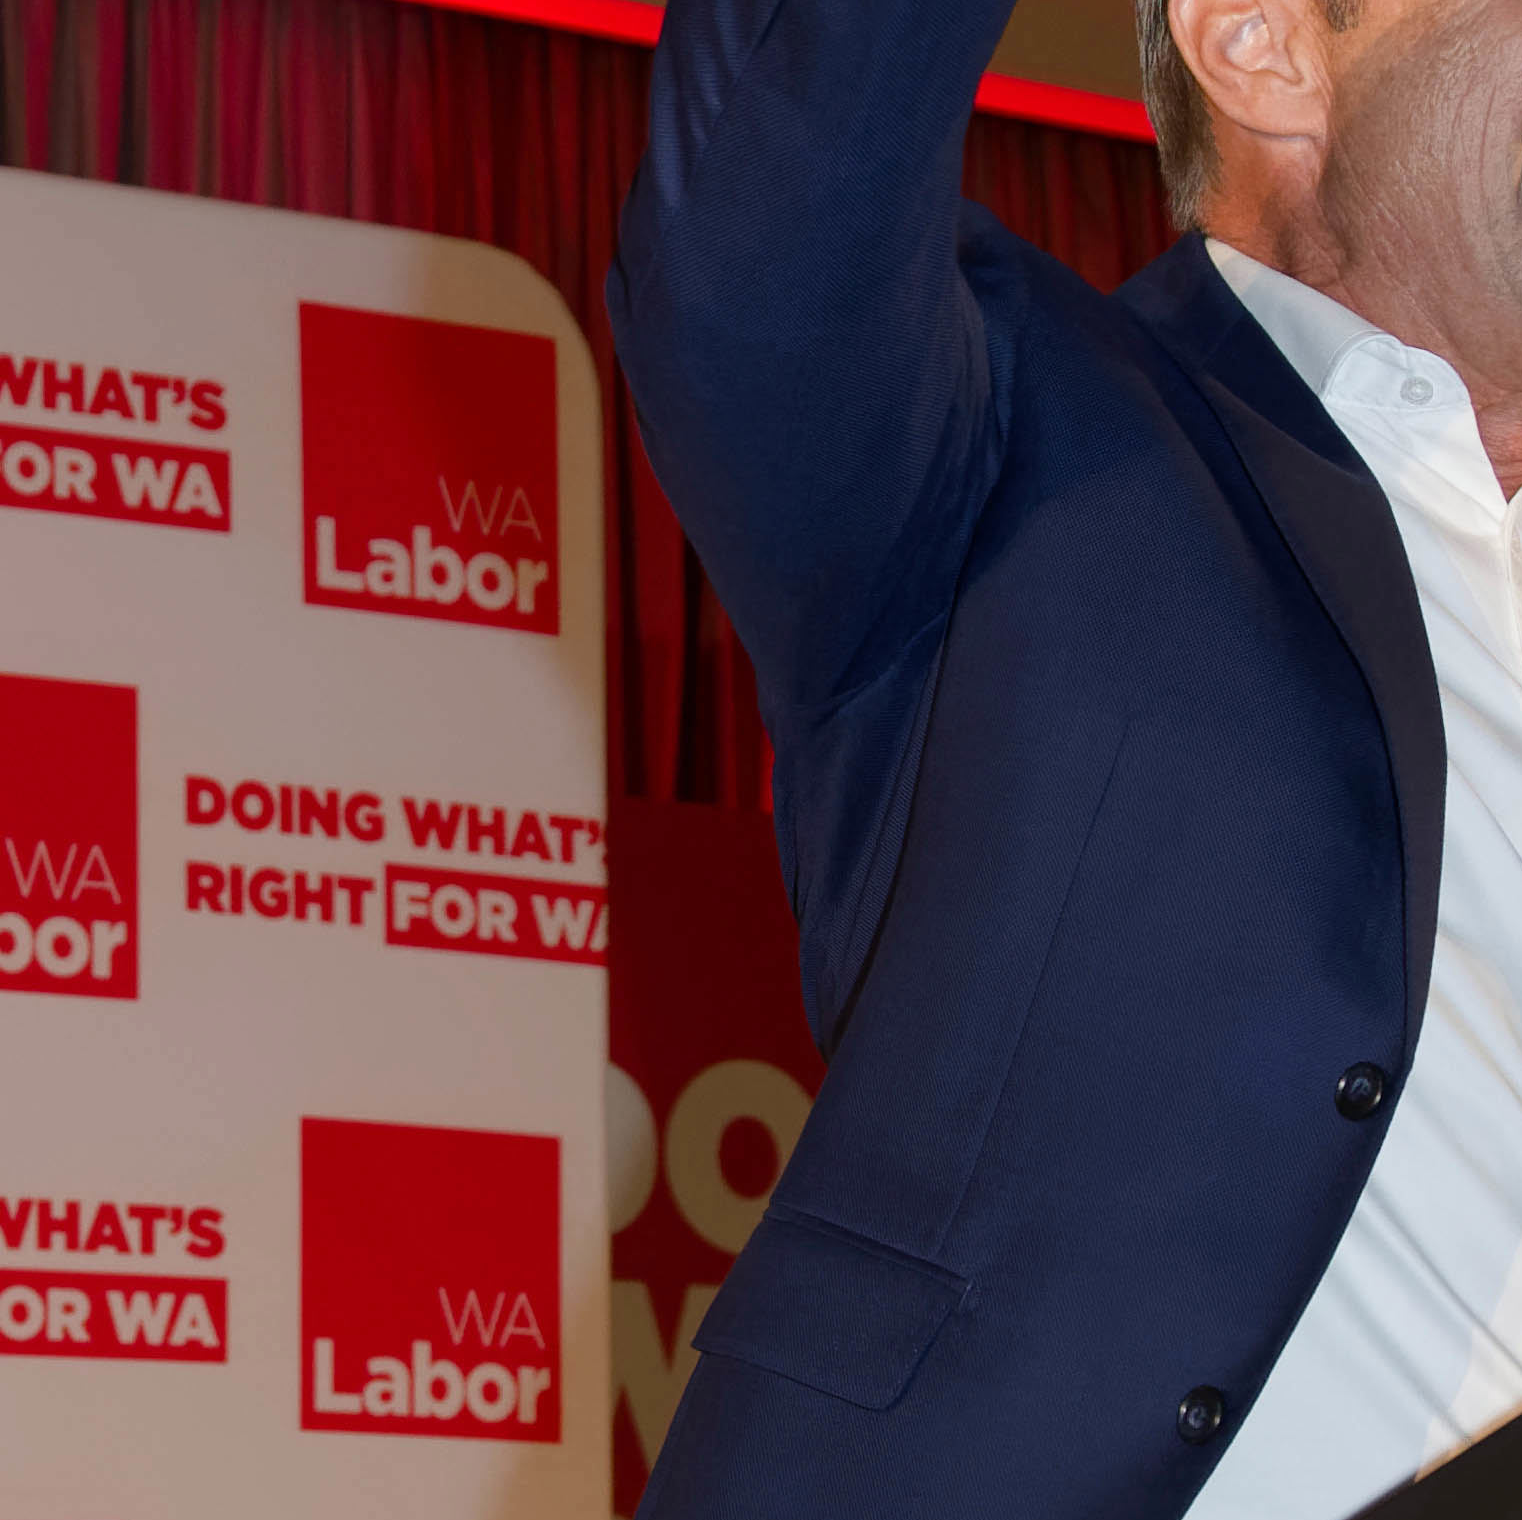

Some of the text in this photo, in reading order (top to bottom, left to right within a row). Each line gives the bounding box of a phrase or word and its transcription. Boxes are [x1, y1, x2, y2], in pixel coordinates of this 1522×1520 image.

[0, 439, 224, 518] OR WA
[438, 475, 543, 543] WA
[315, 515, 548, 615] Labor
[185, 774, 608, 866] DOING WHAT'
[5, 836, 122, 906] WA
[185, 859, 377, 926] RIGHT
[393, 879, 518, 943] FOR
[105, 1288, 221, 1349] WA
[438, 1285, 546, 1350] WA
[313, 1336, 551, 1425] Labor
